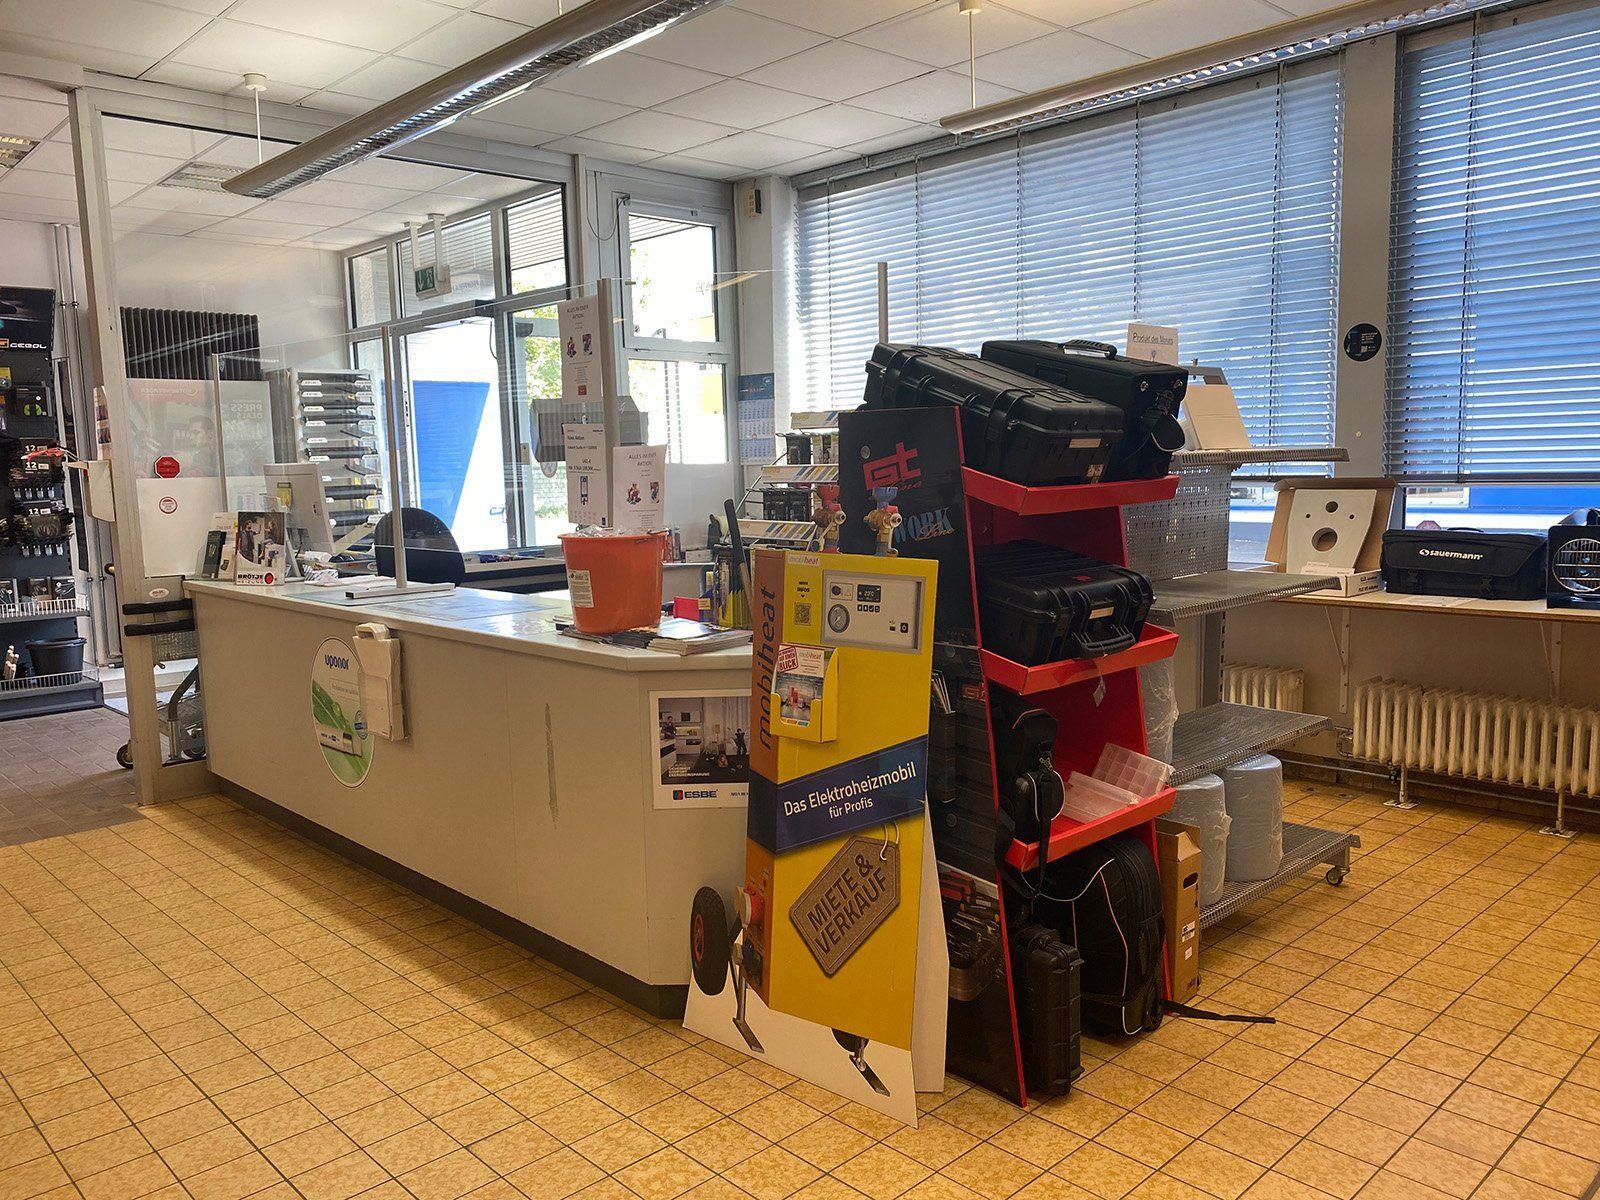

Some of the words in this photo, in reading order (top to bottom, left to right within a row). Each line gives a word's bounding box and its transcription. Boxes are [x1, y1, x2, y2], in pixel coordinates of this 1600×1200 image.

[1430, 550, 1480, 560] sauermann
[324, 654, 349, 671] uponor
[779, 659, 797, 671] BLICK
[684, 790, 717, 799] ESBE
[784, 799, 807, 816] Das
[808, 761, 917, 808] Elektroheizmobil
[828, 805, 843, 819] für
[844, 797, 874, 814] Profis
[806, 867, 859, 932] MIETE
[854, 854, 873, 878] &
[814, 867, 887, 956] VERKAUF
